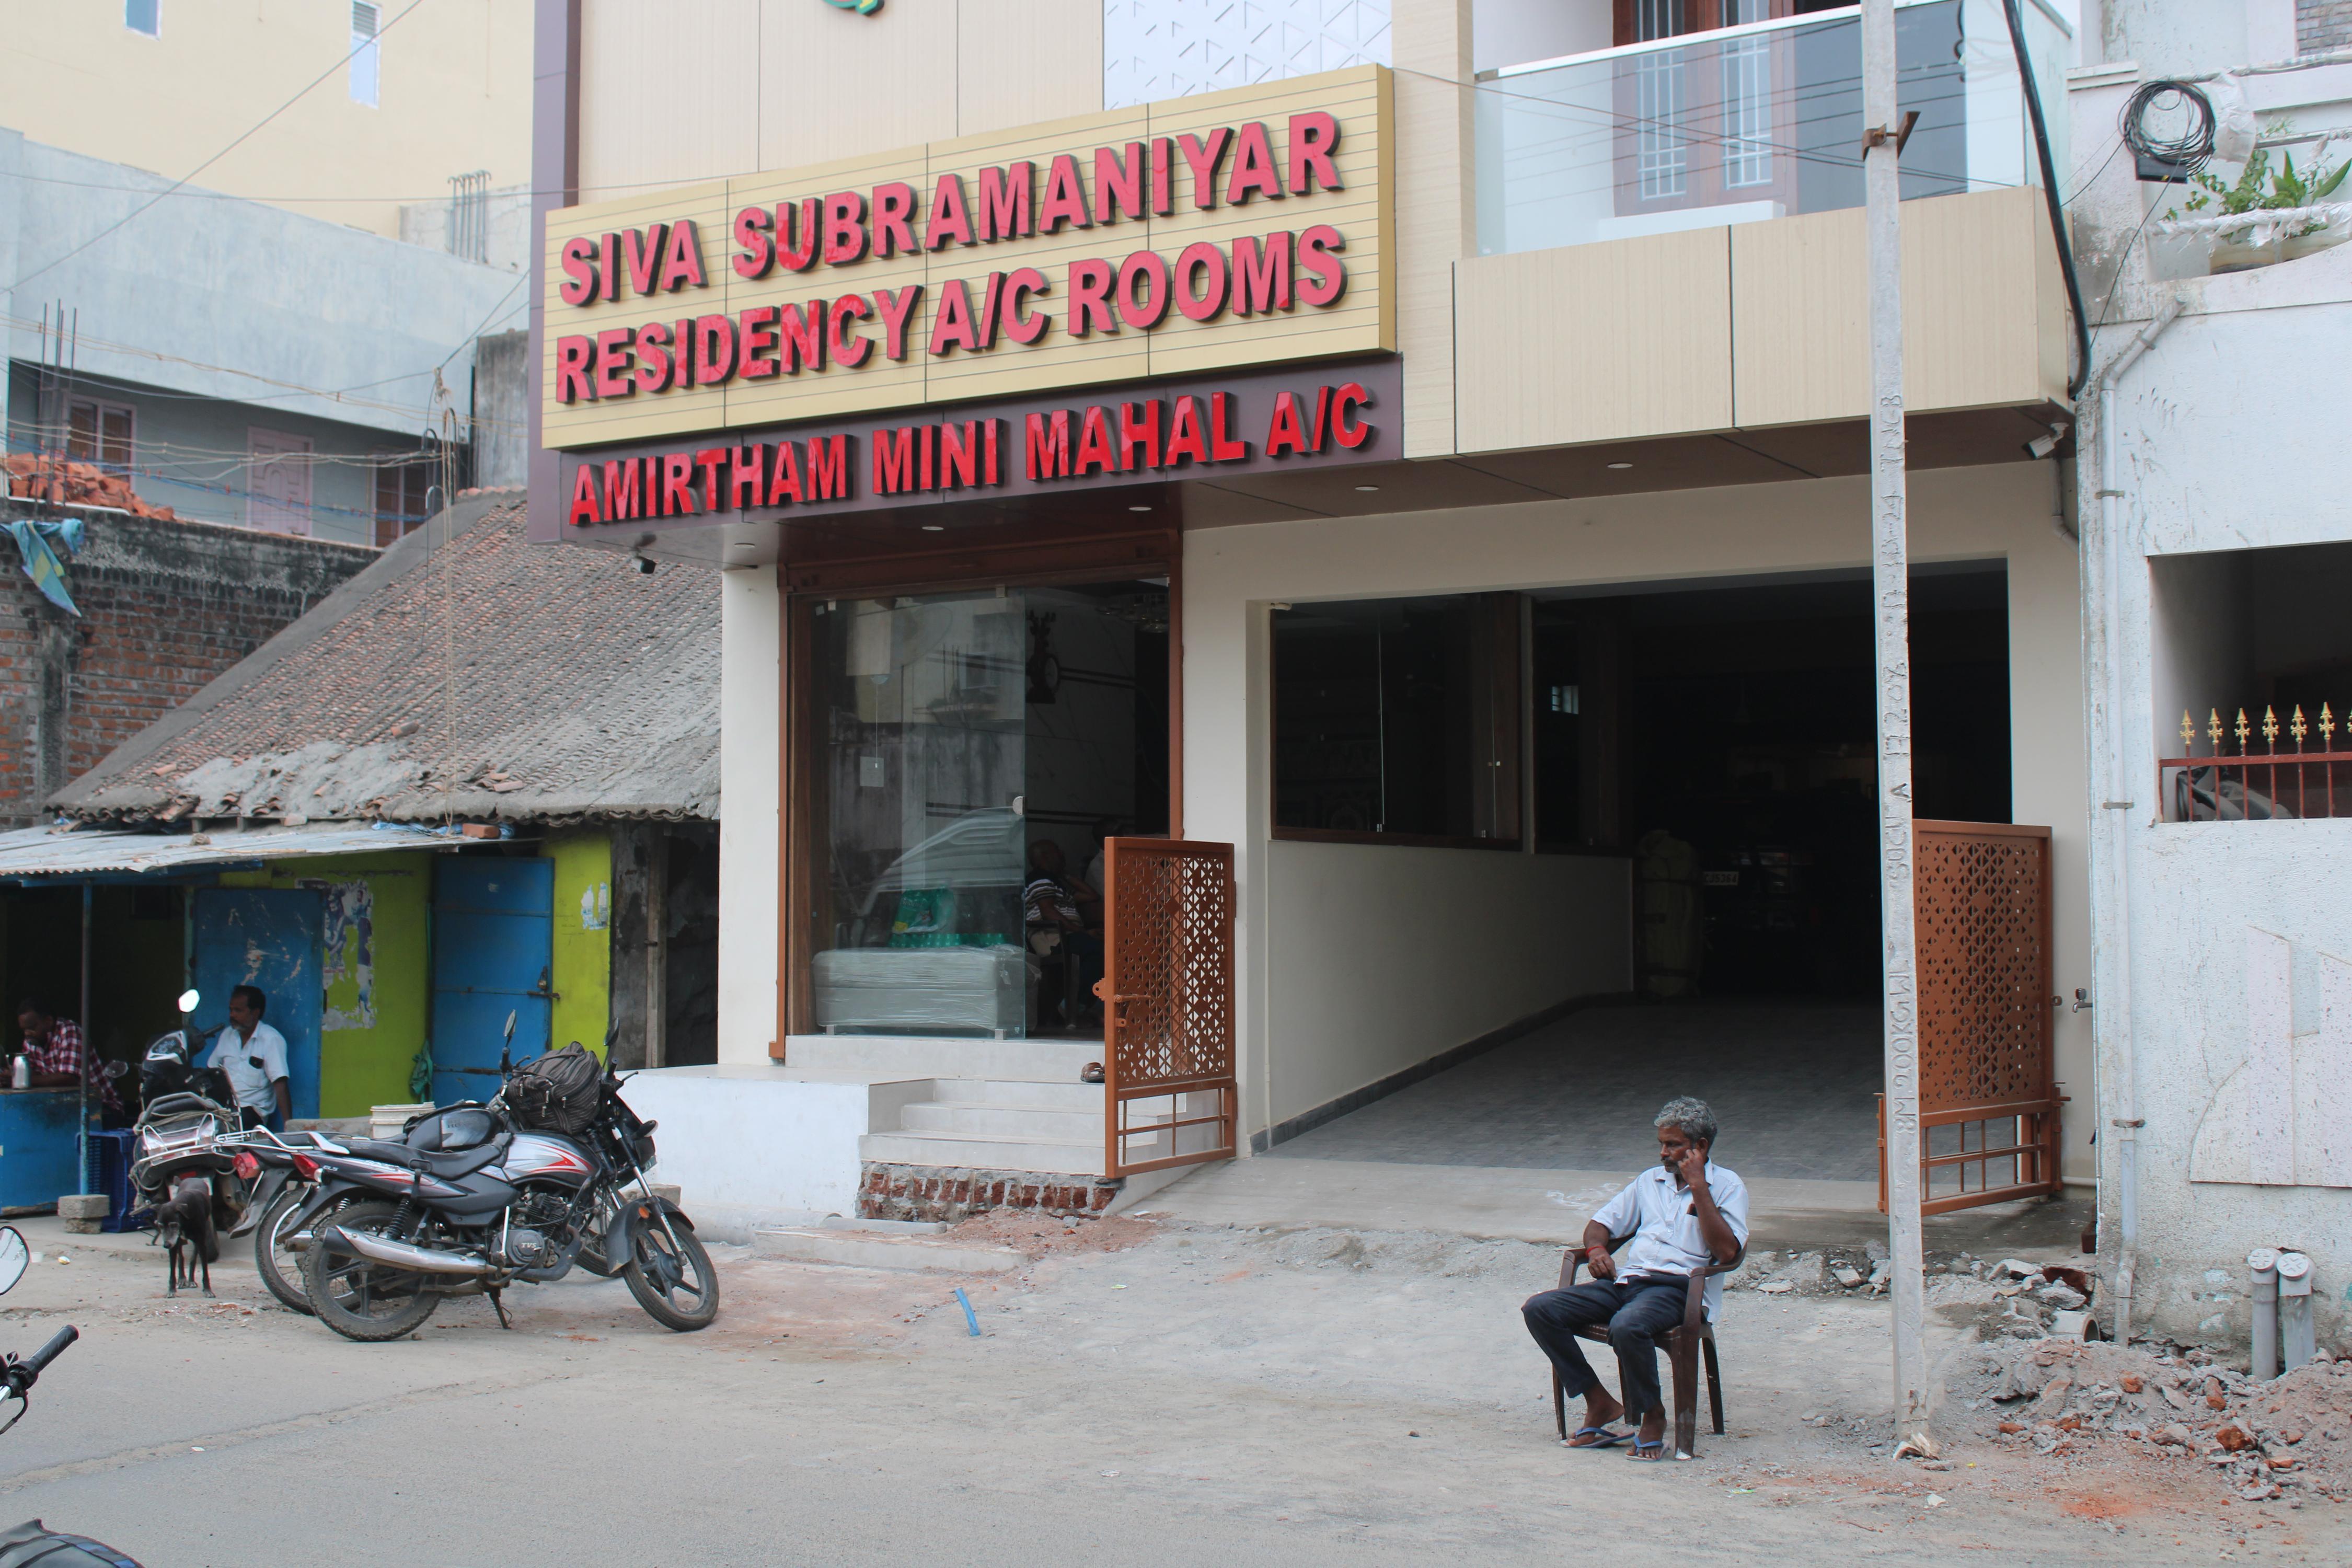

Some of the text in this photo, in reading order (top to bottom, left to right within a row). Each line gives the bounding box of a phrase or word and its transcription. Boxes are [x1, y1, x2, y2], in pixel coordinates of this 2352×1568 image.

[560, 111, 1344, 307] SIVA SUBRAMANIYAR
[556, 224, 1347, 404] RESIDENCY A/C ROOMS
[569, 382, 1375, 526] AMIRTHAM MINI MAHAL A/C
